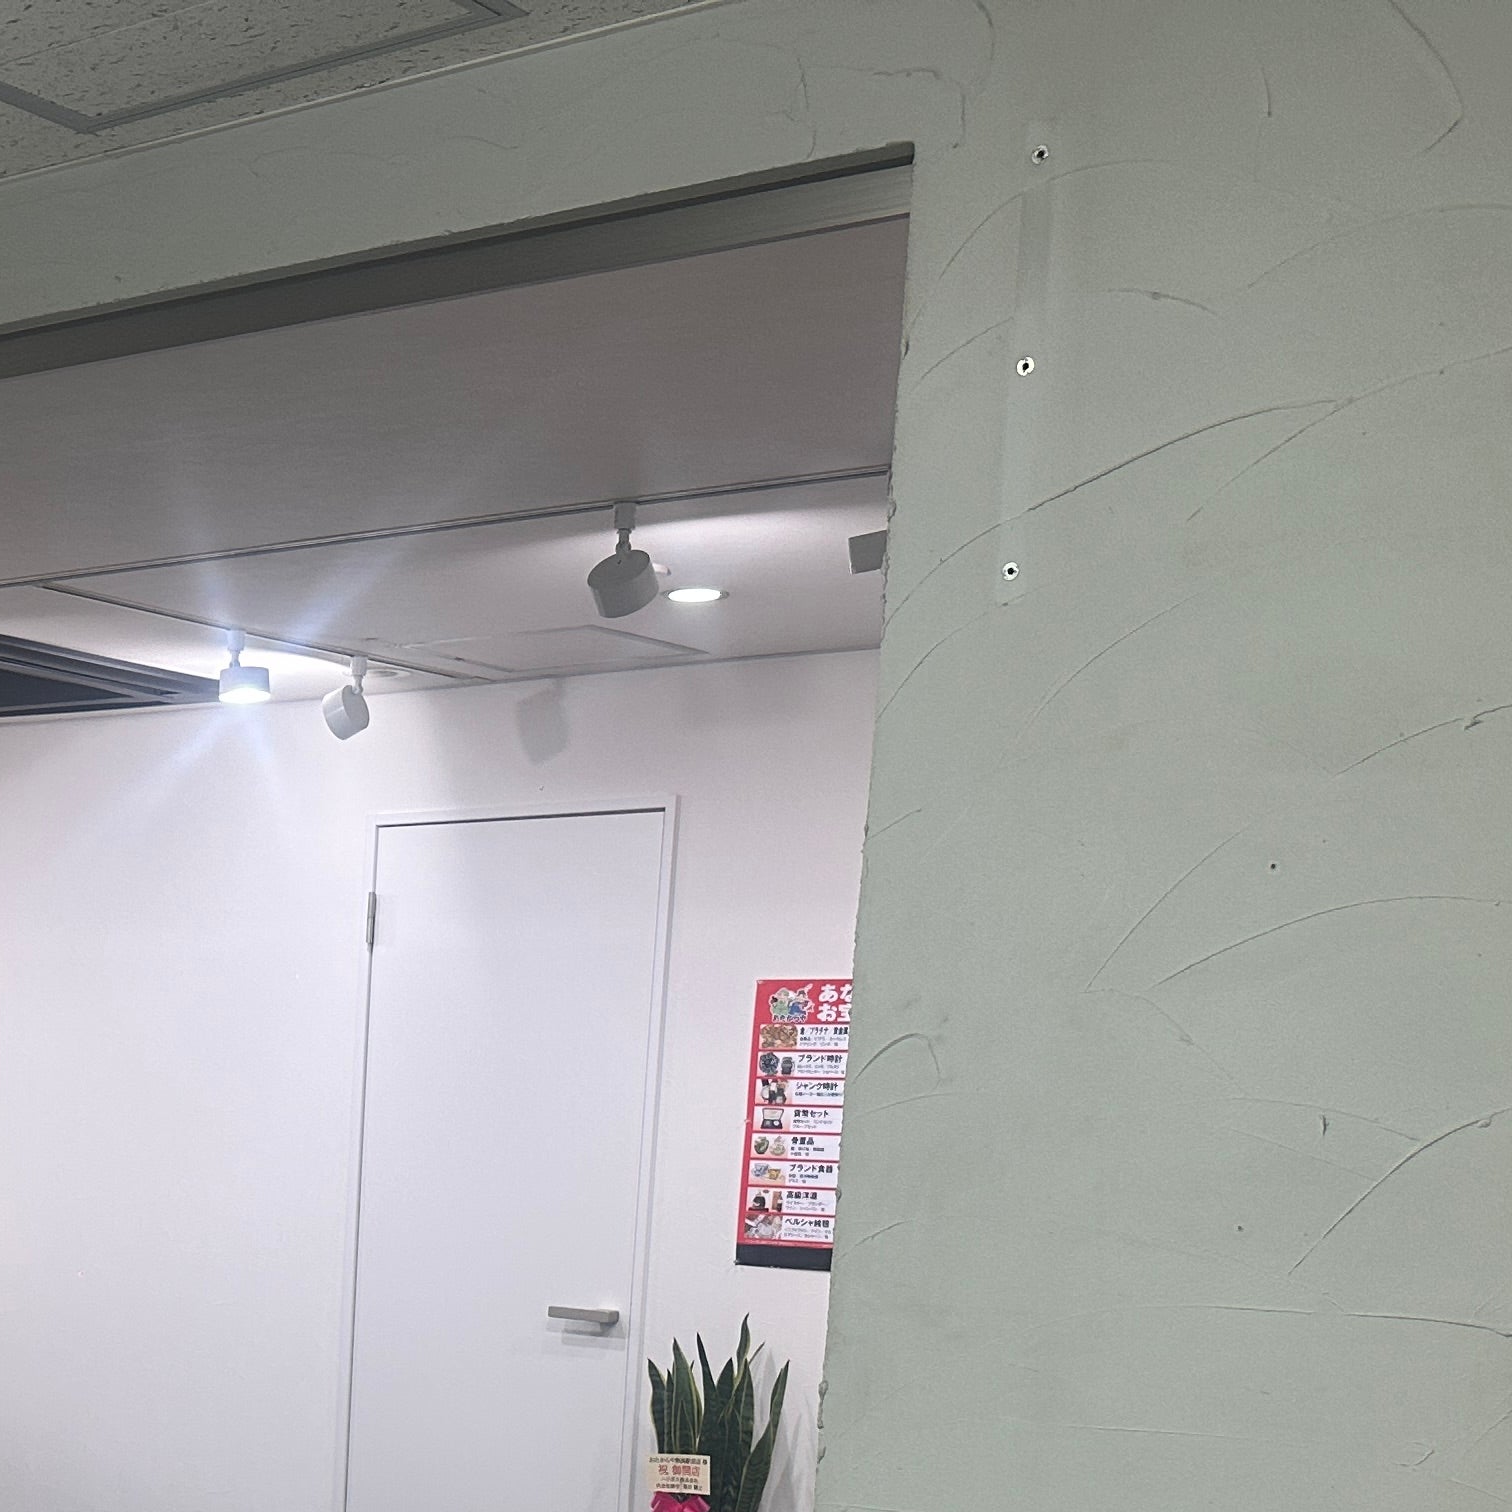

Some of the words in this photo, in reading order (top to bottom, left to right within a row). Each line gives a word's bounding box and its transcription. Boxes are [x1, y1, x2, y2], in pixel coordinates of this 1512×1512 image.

[798, 1054, 843, 1064] ブランド時計
